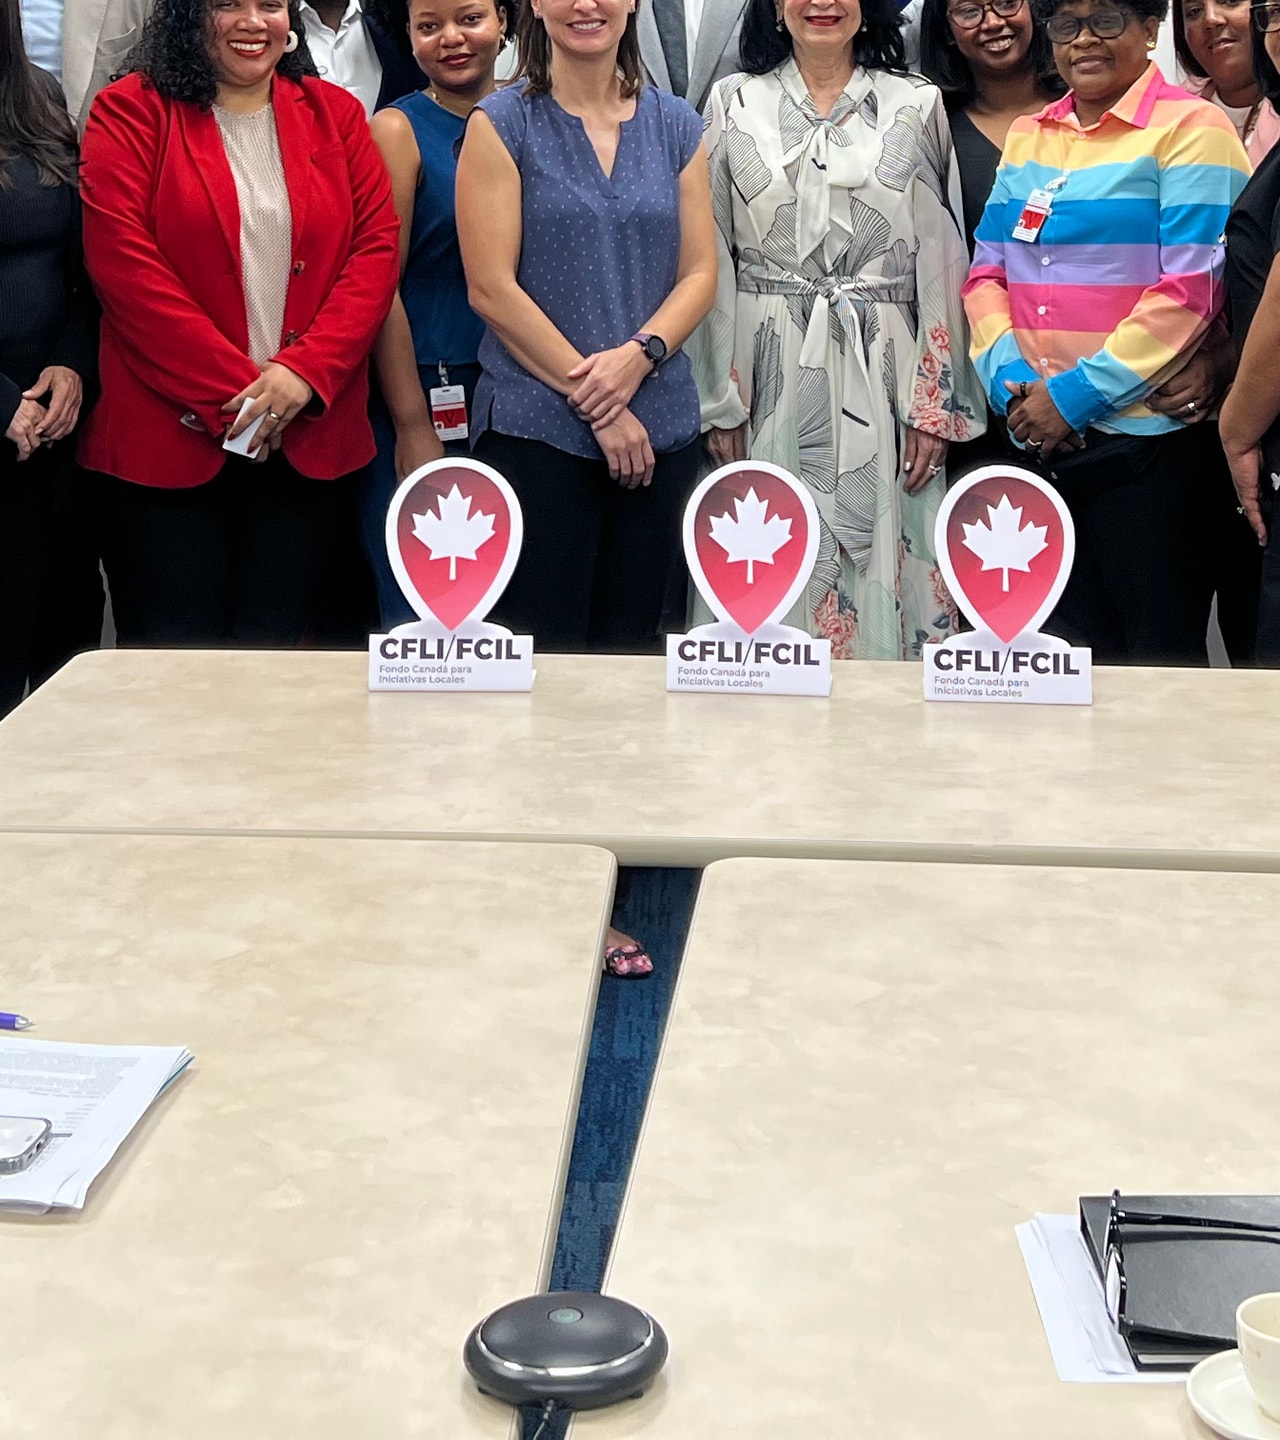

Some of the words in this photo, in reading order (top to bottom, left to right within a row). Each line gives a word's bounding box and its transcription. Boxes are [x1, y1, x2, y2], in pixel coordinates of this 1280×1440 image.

[379, 634, 522, 663] CFLI/FCIL
[677, 637, 820, 666] CFLI/FCIL
[933, 647, 1080, 676] CFLI/FCIL
[379, 665, 410, 674] Fondo
[450, 666, 472, 675] para
[677, 666, 708, 676] Fondo
[749, 670, 770, 679] para
[379, 675, 427, 684] Iniciativas
[429, 675, 465, 684] Locales
[677, 677, 725, 687] Iniciativas
[727, 679, 764, 688] Locales
[934, 676, 965, 685] Fondo
[1007, 679, 1030, 688] para
[934, 686, 983, 696] Iniciativas
[985, 688, 1023, 698] Locales
